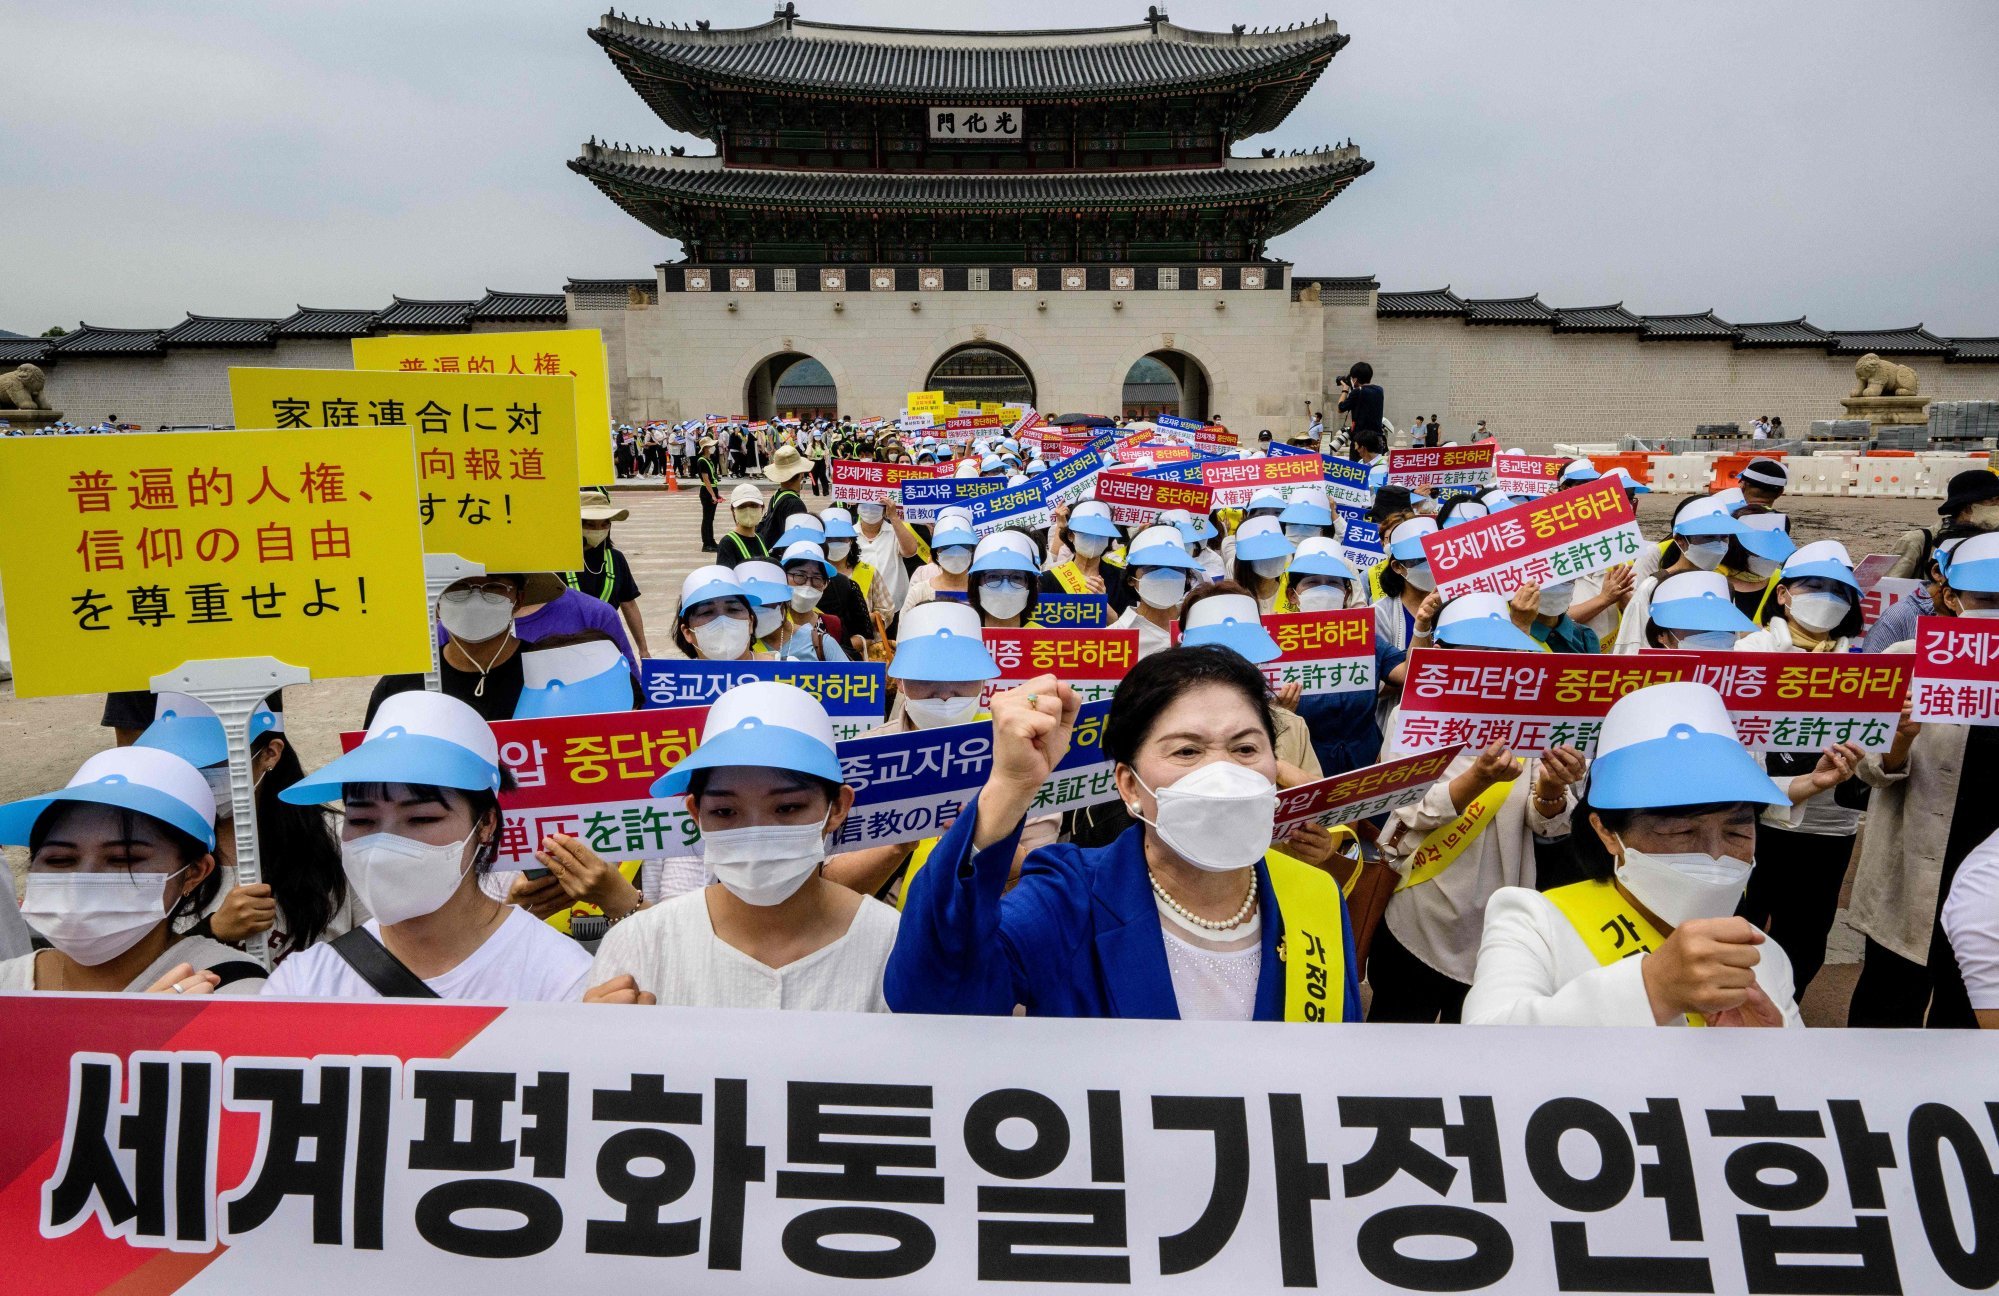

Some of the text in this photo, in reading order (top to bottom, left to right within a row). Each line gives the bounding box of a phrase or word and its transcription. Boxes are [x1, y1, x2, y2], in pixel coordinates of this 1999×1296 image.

[947, 419, 972, 428] 강제개종
[973, 417, 998, 427] 중단하라
[1217, 434, 1237, 443] 중단하라
[420, 447, 546, 480] 向報道
[1053, 452, 1098, 485] 보장하라
[1156, 449, 1189, 459] 중단하라
[1392, 448, 1491, 469] 종교탄압 중단하라
[1499, 460, 1542, 475] 종교탄압
[836, 465, 883, 482] 강제개종
[1206, 460, 1320, 484] 인권탄압 중단하라
[1322, 461, 1367, 484] 보장하라
[67, 462, 375, 514] 普遍的人権、
[904, 484, 952, 499] 종교자유
[989, 486, 1041, 514] 보장하라
[1100, 479, 1209, 507] 인권탄압 중단하라
[1432, 484, 1624, 571] 강제개종 중단하라
[76, 520, 352, 573] 信仰の自由
[1276, 618, 1369, 652] 중단하라
[1030, 639, 1133, 669] 중단하라
[1415, 662, 1550, 701] 종교탄압
[1776, 666, 1904, 699] 중단하라
[840, 737, 992, 790] 종교자유
[1325, 755, 1447, 803] 중단하라
